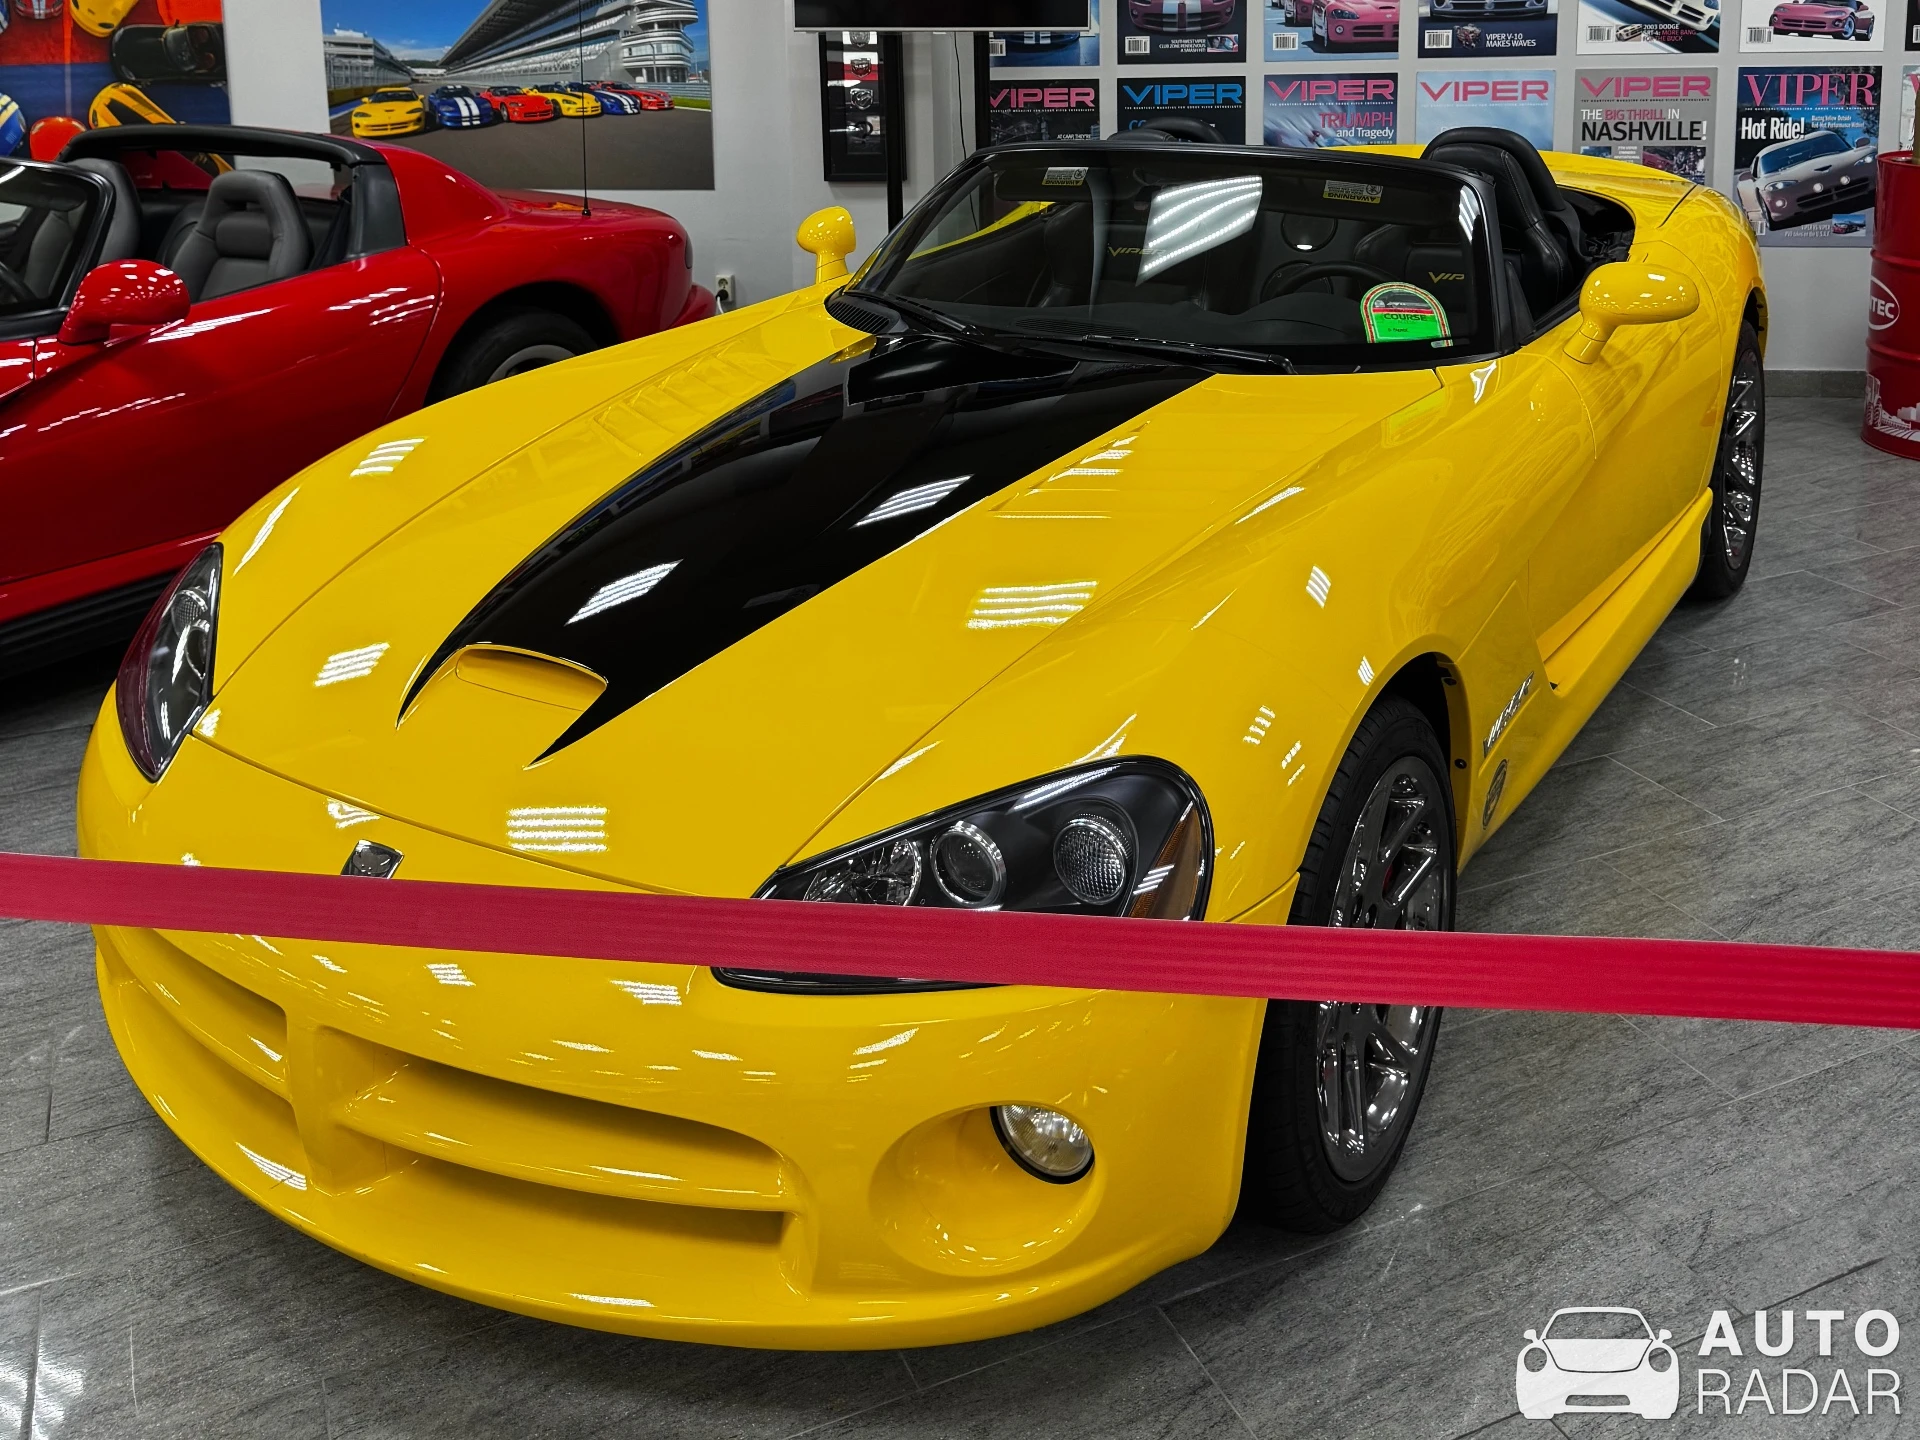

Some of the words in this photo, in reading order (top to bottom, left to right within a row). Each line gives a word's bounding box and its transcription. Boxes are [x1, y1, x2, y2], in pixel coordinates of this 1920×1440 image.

[1123, 84, 1242, 105] VIPER
[1267, 79, 1394, 101] VIPER
[1420, 80, 1549, 101] VIPER
[1580, 75, 1711, 98] VIPER
[1743, 73, 1877, 106] VIPER
[990, 88, 1095, 108] VIPER
[1319, 112, 1393, 128] TRIUMPH
[1580, 109, 1602, 120] THE
[1604, 109, 1626, 120] BIG
[1627, 109, 1666, 120] THRILL
[1668, 108, 1680, 119] IN
[1336, 127, 1354, 137] and
[1356, 127, 1394, 140] Tragedy
[1581, 121, 1707, 141] NASHVILLE!
[1740, 117, 1766, 140] Hot
[1769, 116, 1805, 140] Ride!
[1108, 247, 1166, 257] VIPER
[1383, 313, 1428, 321] COURSE
